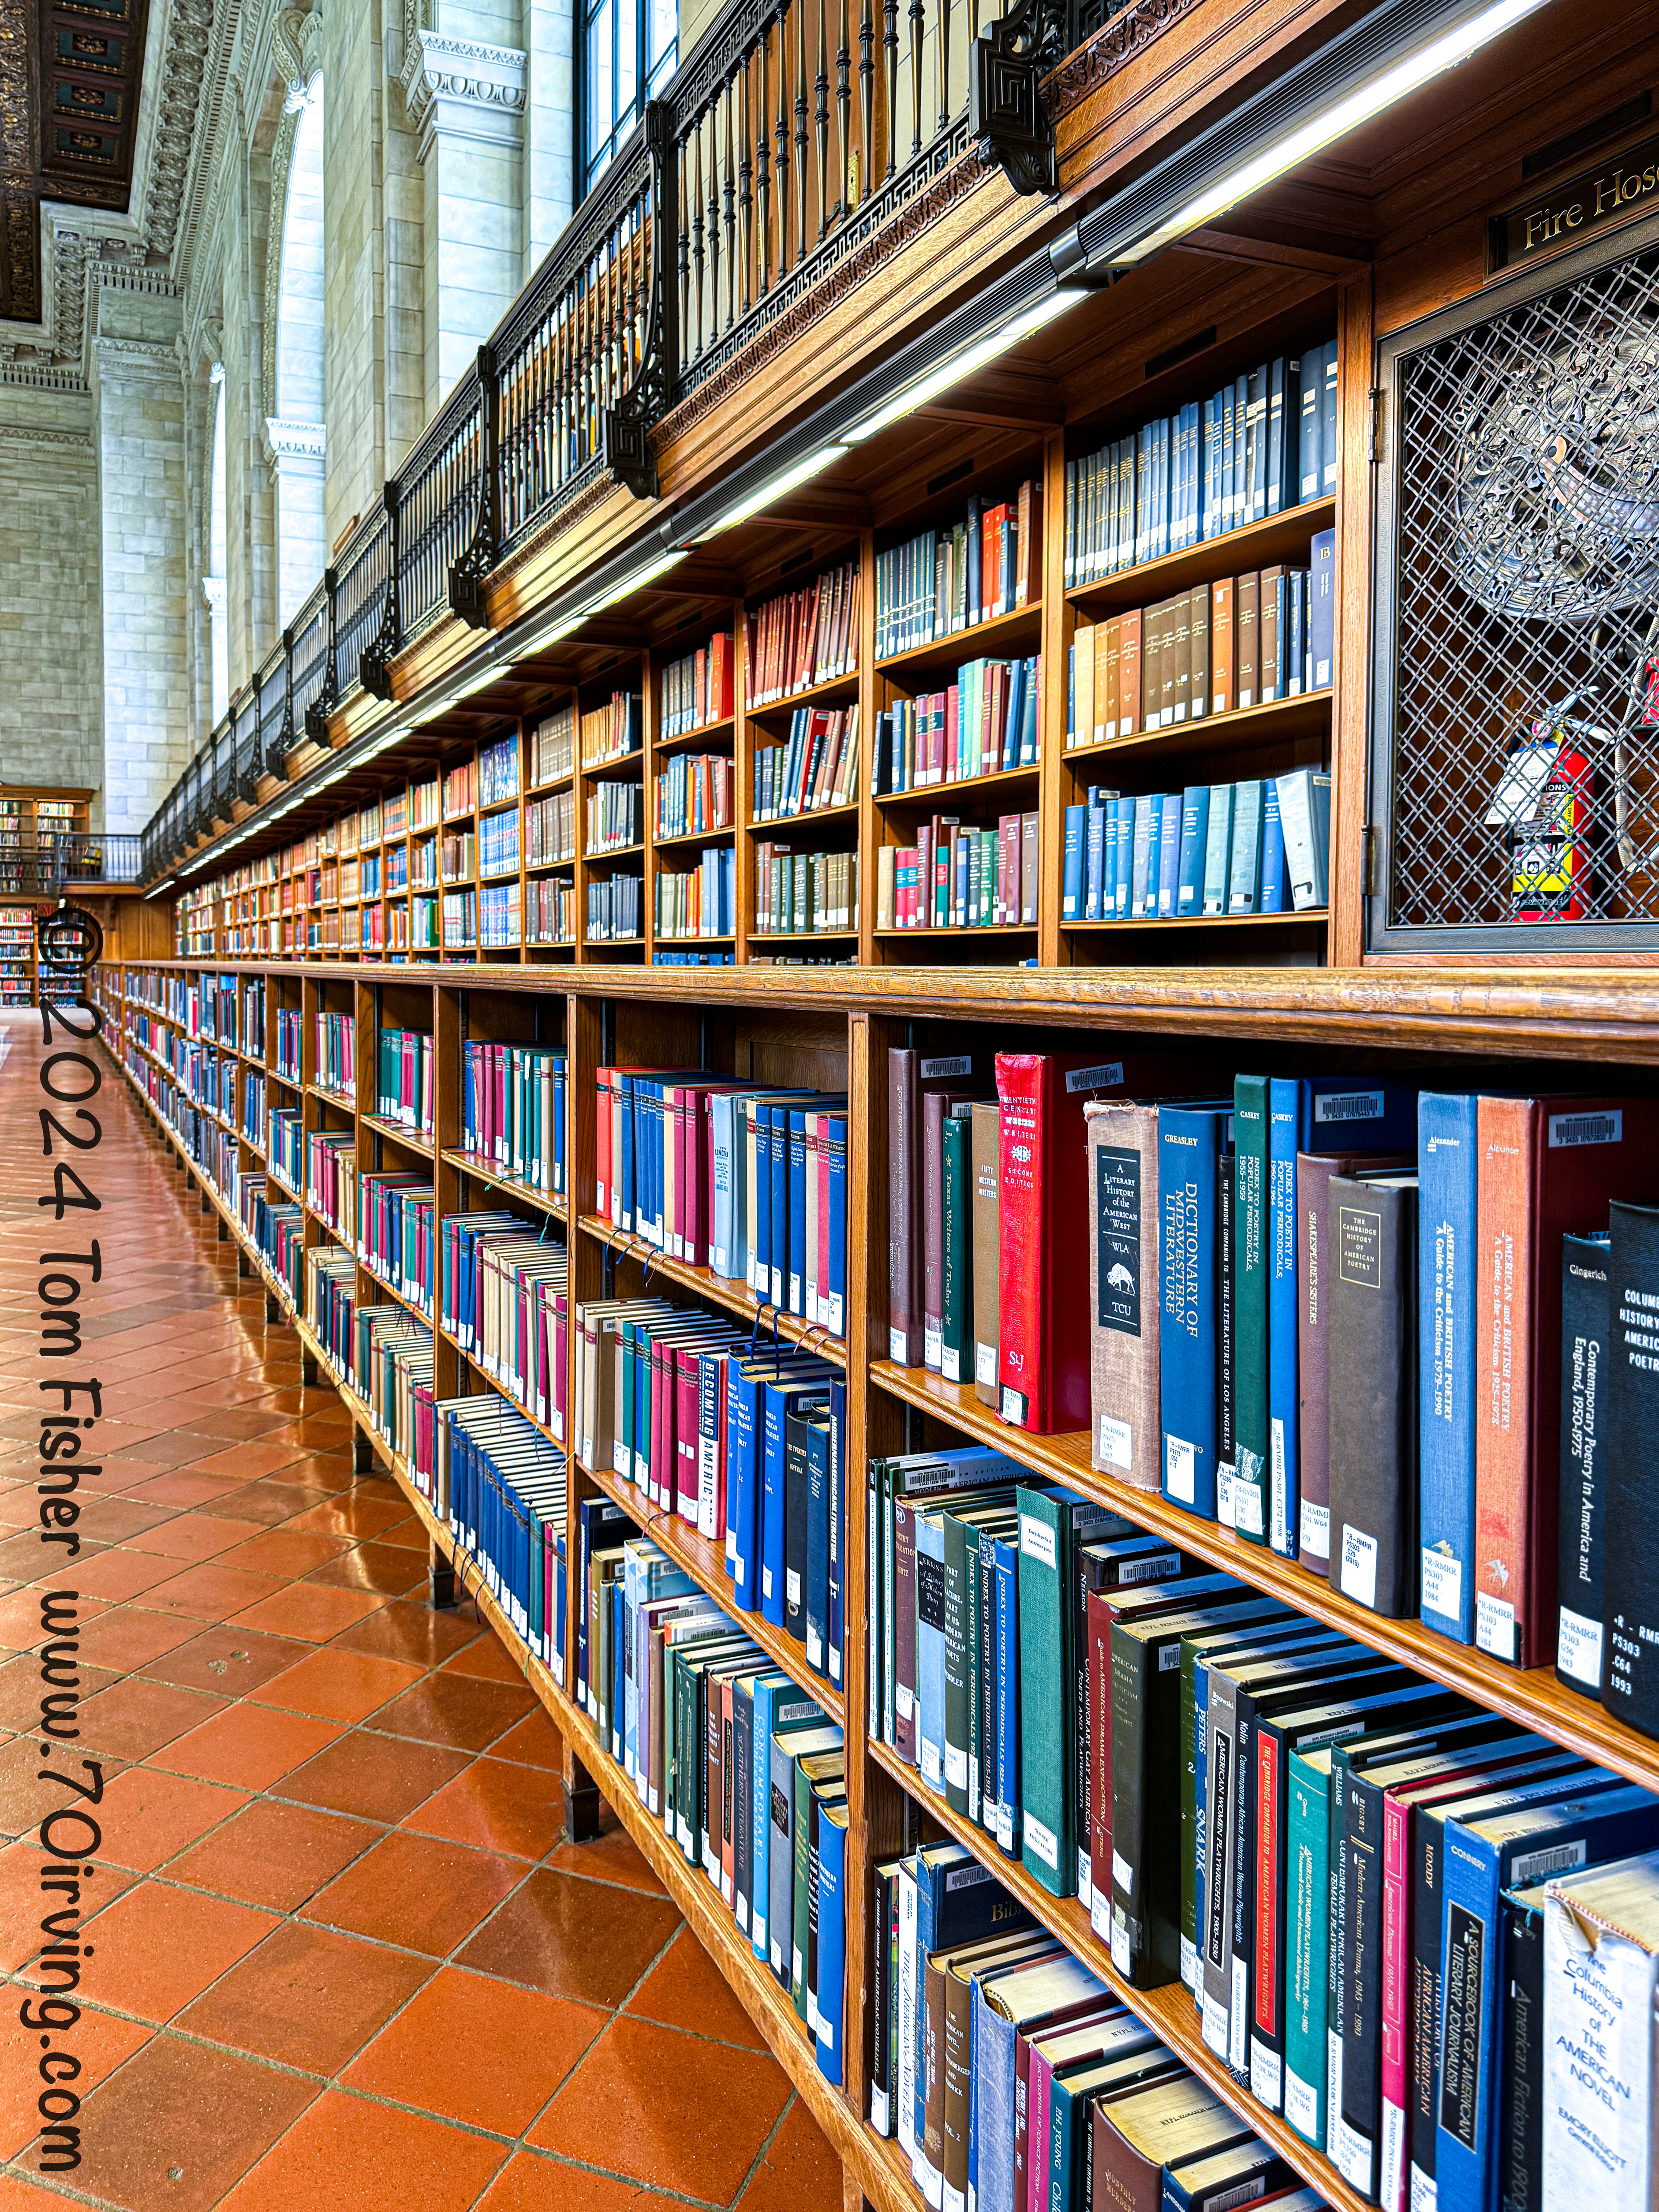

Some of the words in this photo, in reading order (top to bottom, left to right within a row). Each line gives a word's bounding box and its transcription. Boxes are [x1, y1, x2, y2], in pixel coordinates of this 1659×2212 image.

[1524, 203, 1583, 250] Fire
[1593, 165, 1659, 216] Hos
[999, 1096, 1036, 1105] TWENTIETH
[1240, 1110, 1260, 1120] CASKEY
[1271, 1112, 1293, 1122] CASKEY
[1003, 1128, 1036, 1140] WRITERS
[1164, 1134, 1198, 1147] GREASLEY
[1429, 1136, 1460, 1146] Alexander
[1488, 1144, 1519, 1155] Alexander
[979, 1176, 996, 1187] WESTERN
[981, 1165, 993, 1174] FIFTY
[1008, 1167, 1033, 1178] SECOND
[1104, 1173, 1135, 1187] LITERARY
[1117, 1164, 1124, 1173] A
[979, 1188, 997, 1199] WRITERS
[1106, 1185, 1135, 1198] HISTORY
[1112, 1198, 1119, 1207] of
[1121, 1199, 1130, 1208] the
[1252, 1192, 1260, 1201] TO
[1285, 1197, 1293, 1212] TO
[1103, 1207, 1138, 1221] AMERICAN
[1112, 1219, 1131, 1230] WEST
[1342, 1223, 1376, 1236] CAMBRIDGE
[1346, 1233, 1372, 1244] HISTORY
[1436, 1226, 1444, 1235] A
[1112, 1241, 1129, 1254] WLA
[1166, 1193, 1176, 1314] LITERATURE
[1175, 1190, 1185, 1324] MIDWESTERN
[1185, 1182, 1198, 1306] DICTIONARY
[1253, 1251, 1259, 1264] IN
[1275, 1209, 1284, 1279] PERIODICALS,
[1309, 1211, 1317, 1285] SHAKESPEARE'S
[1344, 1250, 1375, 1262] AMERICAN
[1436, 1238, 1444, 1270] Guide
[1445, 1224, 1454, 1290] AMERICAN
[946, 1255, 952, 1269] of
[1284, 1258, 1292, 1270] IN
[1348, 1260, 1370, 1271] POETRY
[1503, 1234, 1513, 1301] AMERICAN
[1569, 1264, 1607, 1281] Gingerich
[1436, 1273, 1443, 1284] to
[1112, 1302, 1131, 1316] TCU
[1309, 1286, 1318, 1325] SISTERS
[1435, 1287, 1444, 1304] the
[1445, 1293, 1453, 1314] and
[1186, 1310, 1198, 1338] OF
[1503, 1305, 1512, 1324] and
[1435, 1307, 1443, 1356] Criticism
[1445, 1318, 1453, 1369] BRITISH
[1503, 1328, 1512, 1378] BRITISH
[1572, 1337, 1587, 1394] England,
[1224, 1368, 1230, 1381] OF
[1434, 1360, 1443, 1415] 1979-1990
[1584, 1341, 1600, 1435] Contemporary
[705, 1361, 715, 1436] BECOMING
[1444, 1373, 1452, 1423] POETRY
[1501, 1382, 1511, 1432] POETRY
[1570, 1395, 1585, 1460] 1950-1975
[1582, 1437, 1596, 1480] Poetry
[1582, 1482, 1592, 1495] in
[1581, 1497, 1595, 1553] America
[1346, 1556, 1360, 1569] (2015)
[1579, 1555, 1592, 1583] and
[1478, 1610, 1497, 1626] PS303
[1612, 1633, 1640, 1658] PS303
[1611, 1674, 1632, 1696] 1993
[1212, 1691, 1234, 1710] Bzowski
[1198, 1707, 1207, 1755] PETERS
[1239, 1720, 1249, 1745] Kolin
[1217, 1738, 1226, 1795] AMERICAN
[1216, 1796, 1224, 1832] WOMEN
[1196, 1804, 1207, 1879] SNARK
[1425, 1843, 1433, 1888] MOODY
[1450, 1845, 1486, 1871] CONNERY
[1357, 1856, 1366, 1893] Modern
[1235, 1899, 1243, 1943] Playwrights
[1357, 1894, 1366, 1939] American
[1469, 1921, 1478, 1933] A
[1211, 1914, 1220, 1960] 1900-1930
[1329, 1917, 1338, 1993] PLAYWRIGHTS
[1354, 1942, 1365, 1975] Drama,
[1450, 1942, 1465, 2005] LITERARY
[1465, 1934, 1478, 2037] SOURCEBOOK
[1566, 1958, 1623, 2010] Columbia
[1422, 1964, 1433, 2034] AFRICAN
[1573, 1982, 1616, 2026] History
[1354, 2013, 1362, 2036] 1990
[1515, 1985, 1532, 2073] American
[1589, 2018, 1602, 2032] of
[1446, 2005, 1460, 2096] JOURNALISM
[1463, 2038, 1475, 2061] OF
[1582, 2029, 1608, 2060] THE
[1421, 2037, 1431, 2117] AMERICAN
[1556, 2035, 1631, 2099] AMERICAN
[1459, 2062, 1473, 2139] AMERICAN
[1570, 2063, 1616, 2111] NOVEL
[1514, 2078, 1530, 2137] Fiction
[1514, 2141, 1526, 2159] to
